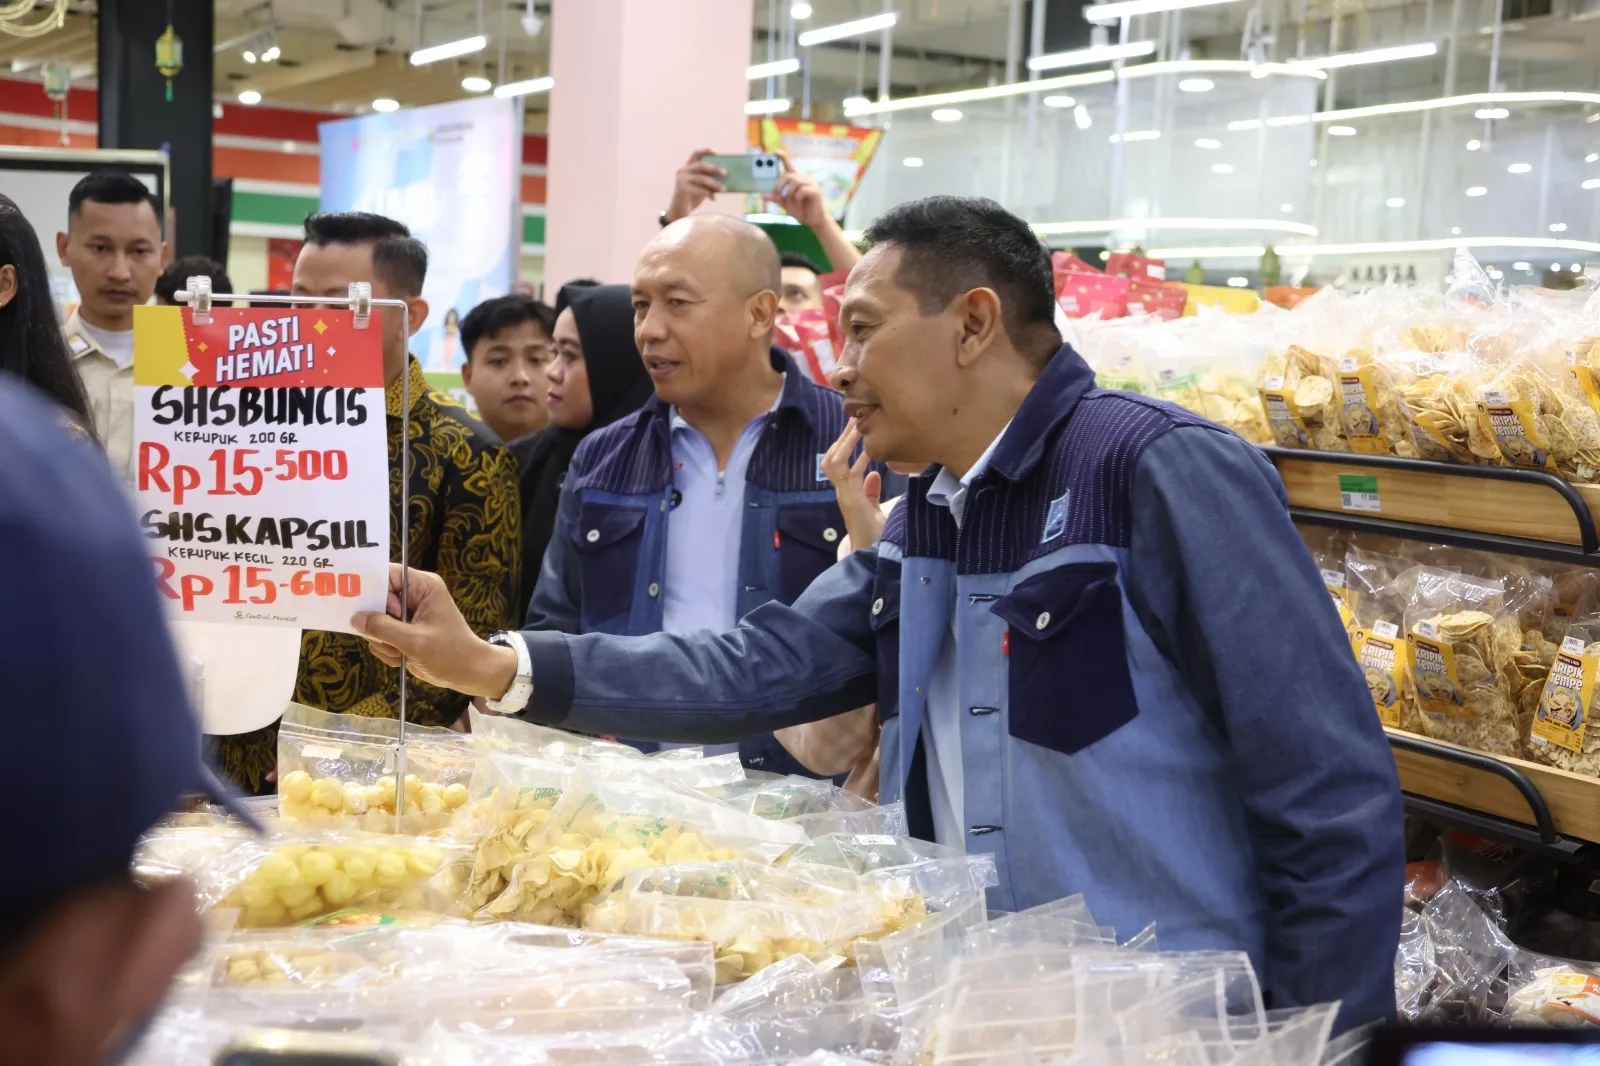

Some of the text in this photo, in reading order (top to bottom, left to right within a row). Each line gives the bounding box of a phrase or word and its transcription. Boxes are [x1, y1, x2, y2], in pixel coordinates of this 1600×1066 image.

[228, 315, 300, 351] PASTI
[215, 343, 315, 383] HEMAT!
[1489, 415, 1521, 427] KRIPIK
[174, 431, 298, 445] KERUPUK 200 GR
[138, 441, 201, 506] Rp
[140, 509, 379, 551] SHS KAPSUL
[168, 547, 334, 568] KERUPUK KECIL 220 GR
[272, 614, 298, 622] Market
[1360, 644, 1396, 661] KRIPIK
[1415, 647, 1444, 664] KRIPIK
[1553, 662, 1585, 680] KRIPIK
